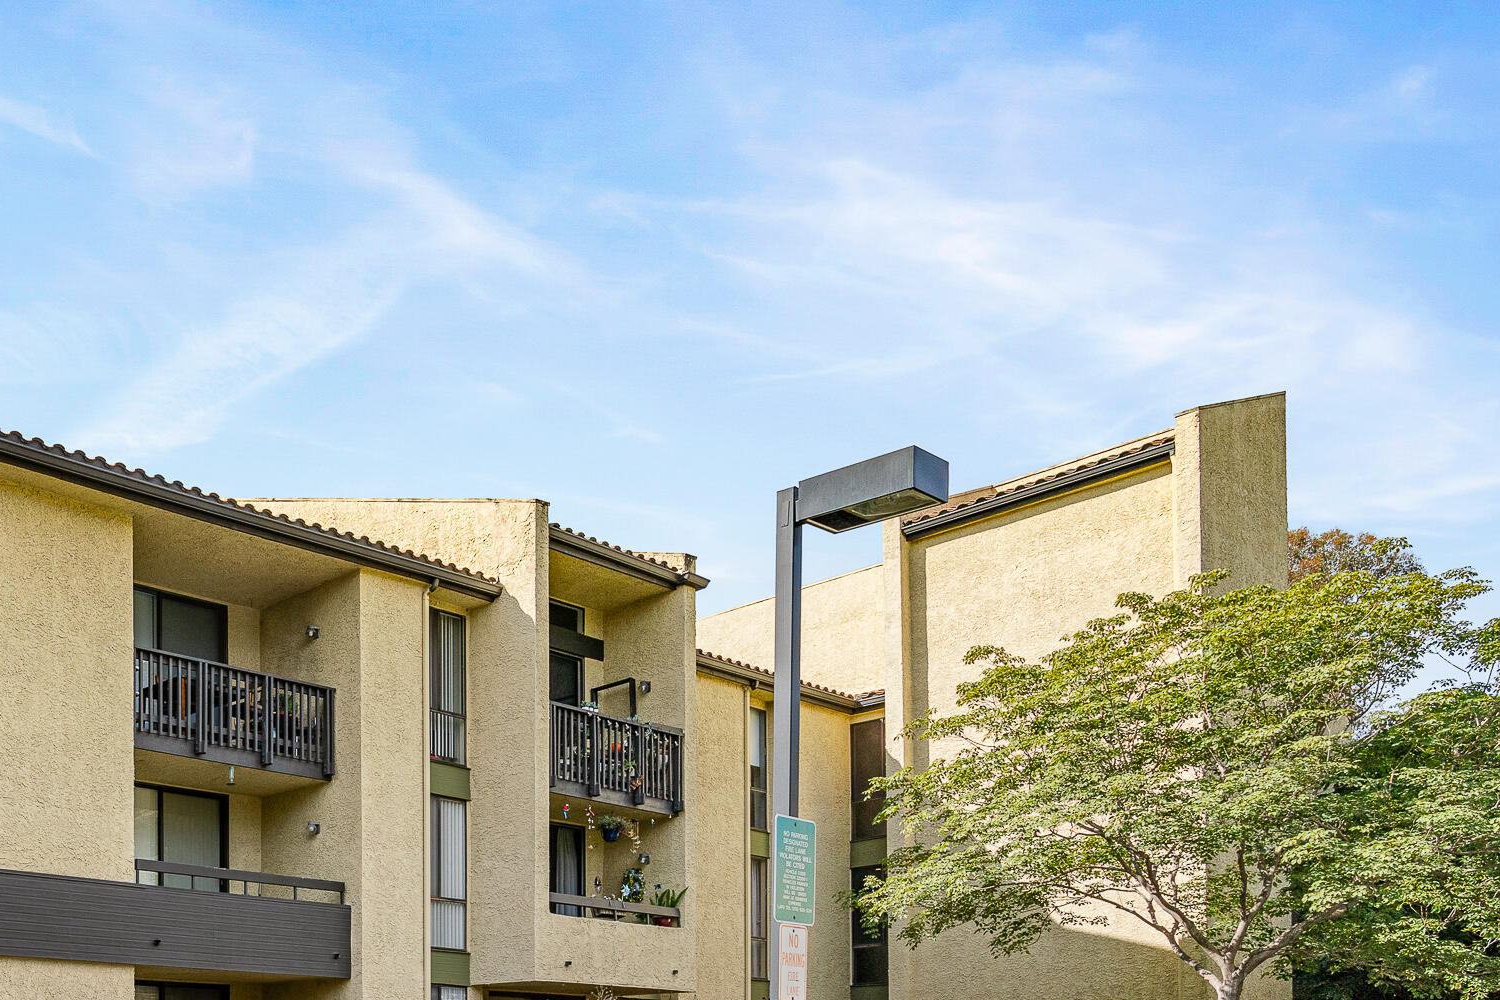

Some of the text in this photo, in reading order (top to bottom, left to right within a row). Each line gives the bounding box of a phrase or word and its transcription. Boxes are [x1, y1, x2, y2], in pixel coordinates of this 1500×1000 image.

[790, 832, 808, 840] PARKING
[783, 838, 808, 848] DESIGNATED
[780, 852, 812, 864] VIOLATORS WILL
[788, 934, 798, 948] NO
[782, 952, 804, 968] PARKING
[788, 971, 799, 981] FIRE
[786, 986, 799, 996] LANE
